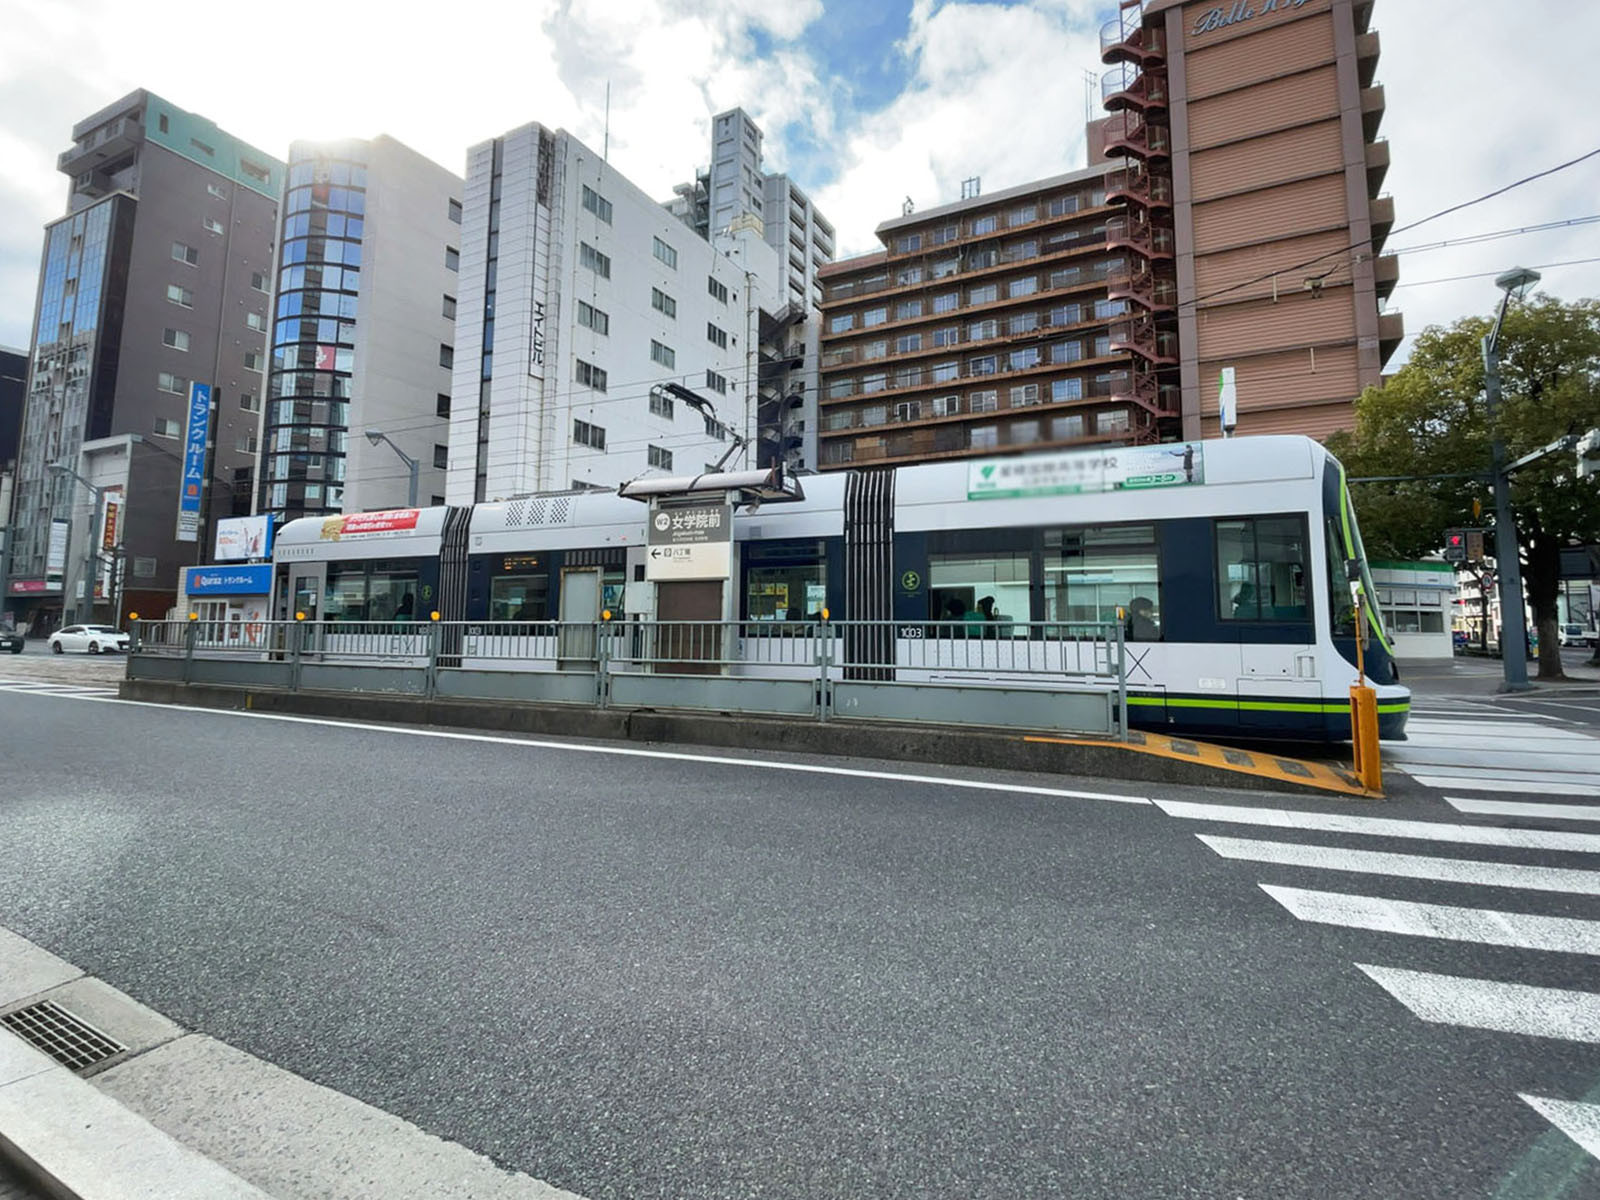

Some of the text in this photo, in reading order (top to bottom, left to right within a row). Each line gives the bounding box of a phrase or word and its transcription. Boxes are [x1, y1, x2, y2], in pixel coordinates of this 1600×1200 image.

[187, 390, 207, 479] トランクルーム
[672, 514, 720, 529] 女学院前
[900, 627, 922, 639] 1003
